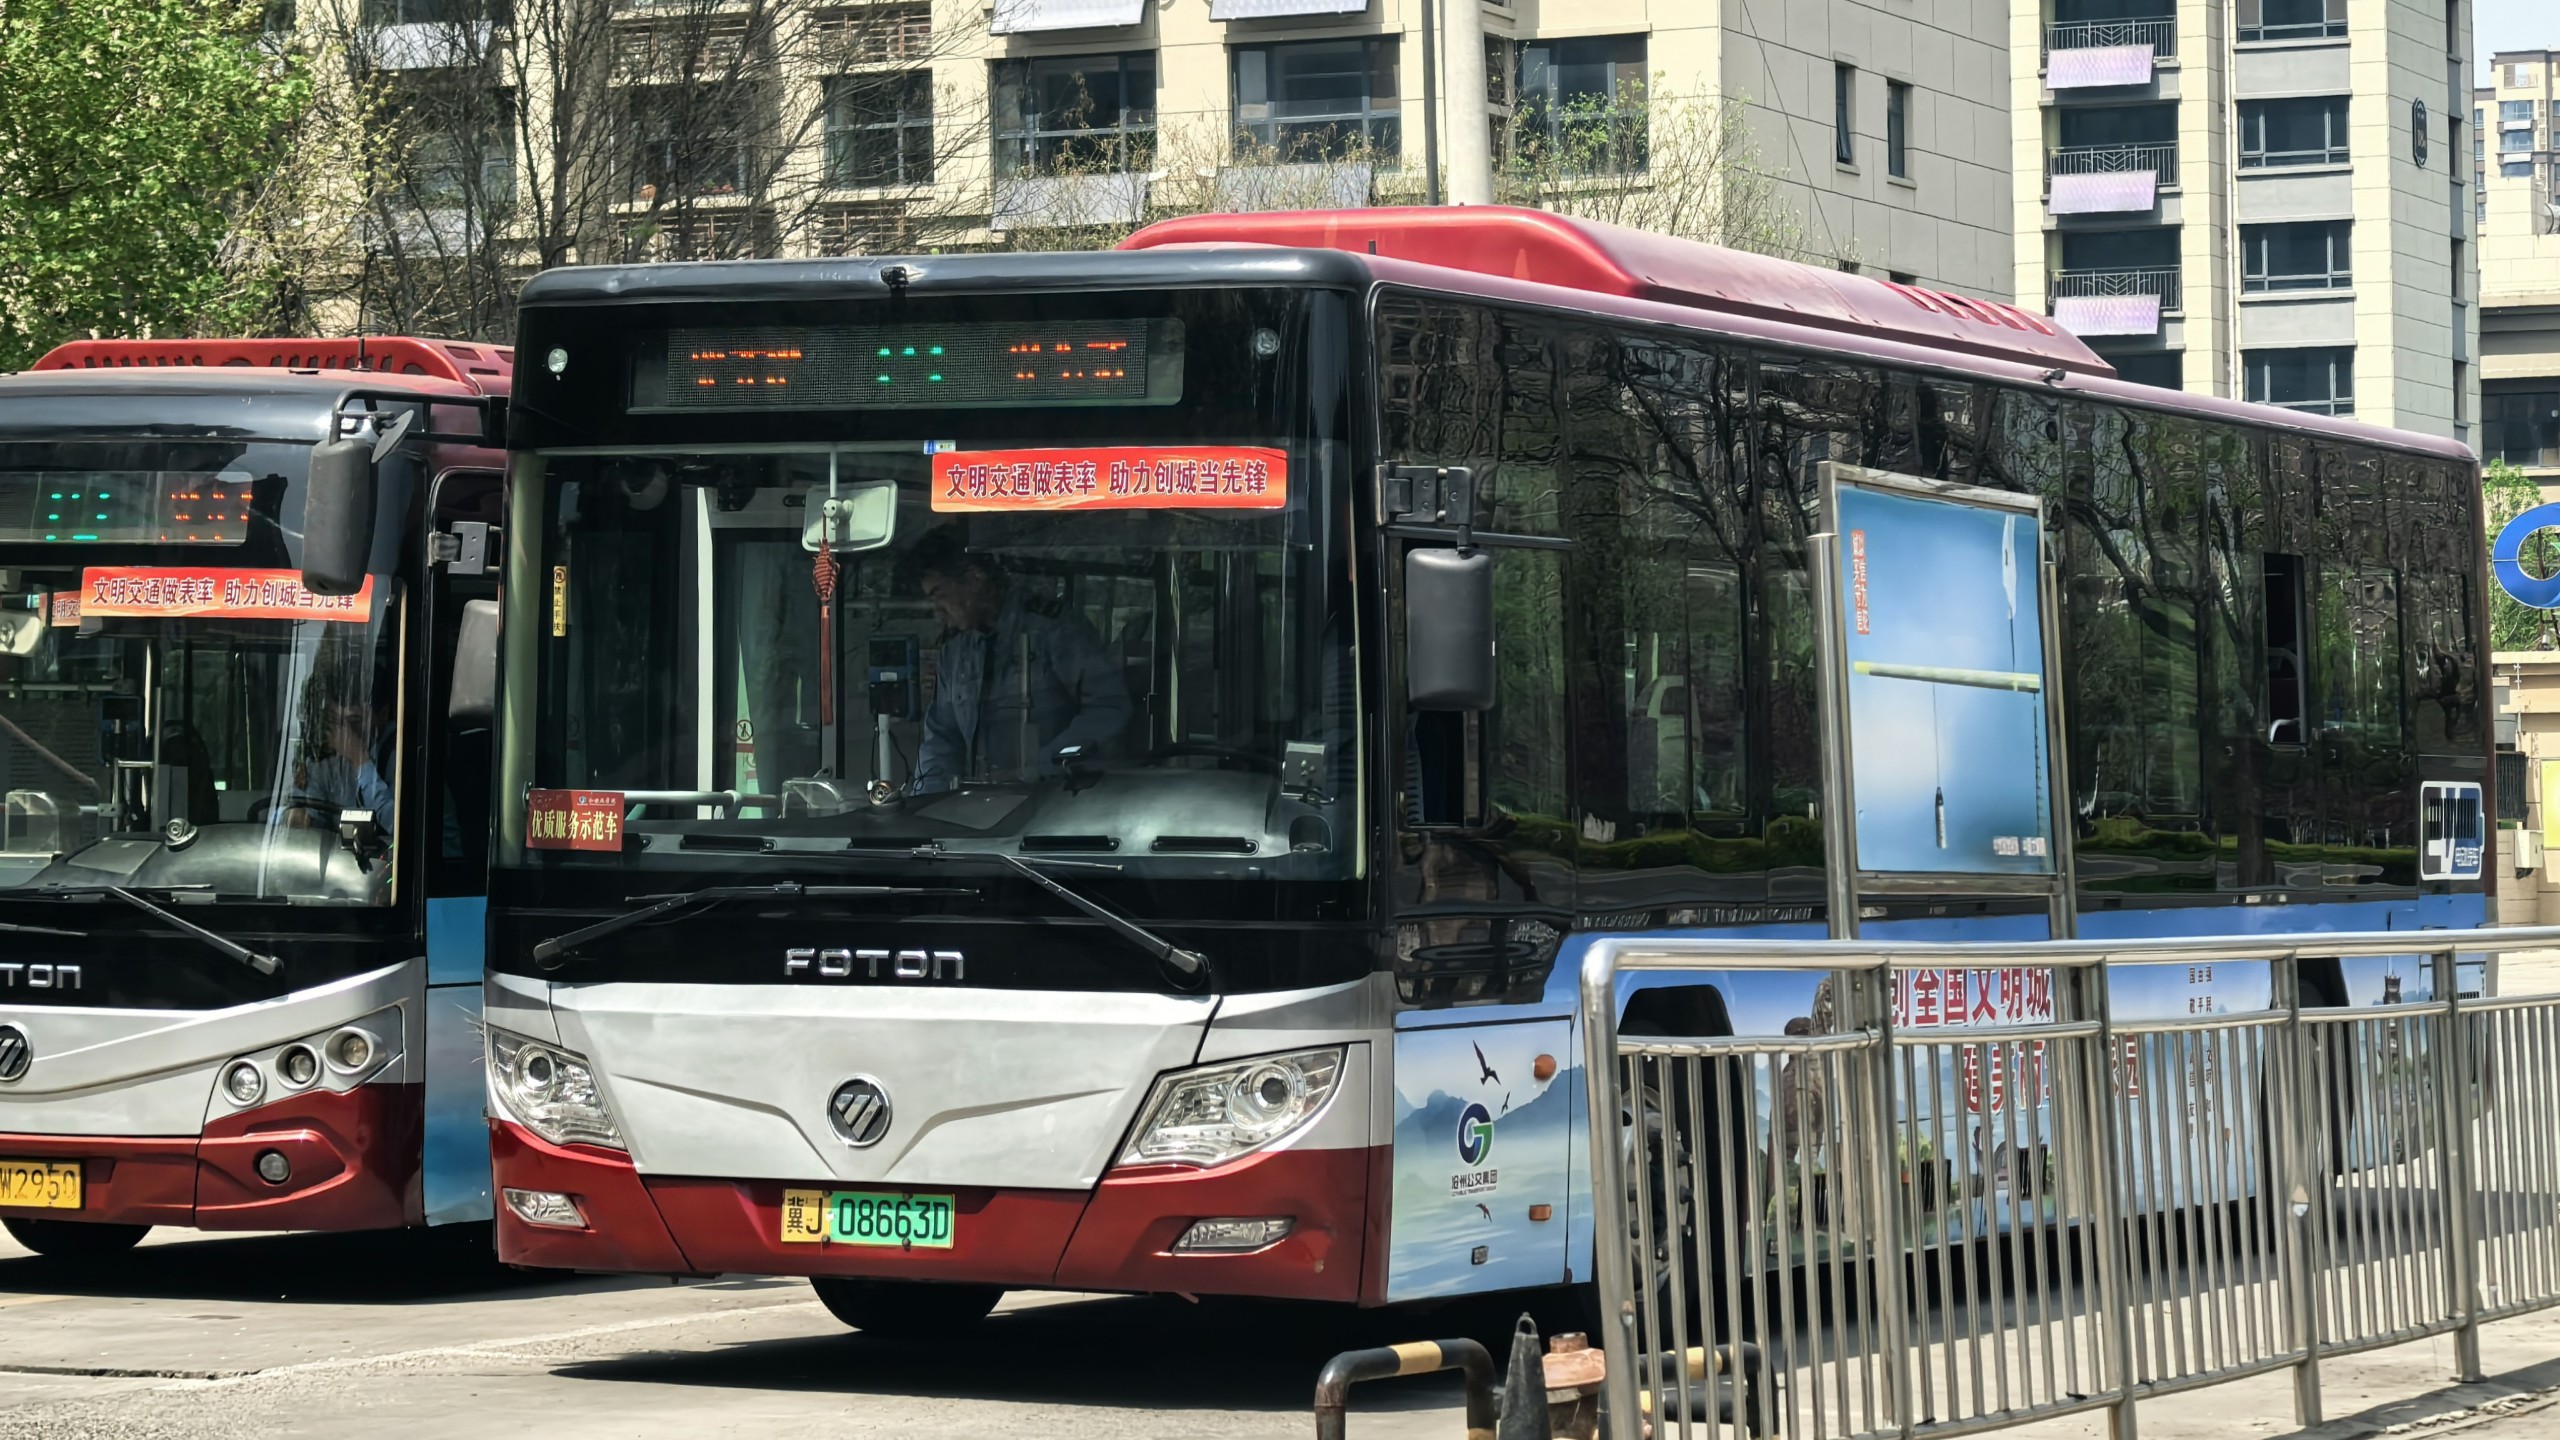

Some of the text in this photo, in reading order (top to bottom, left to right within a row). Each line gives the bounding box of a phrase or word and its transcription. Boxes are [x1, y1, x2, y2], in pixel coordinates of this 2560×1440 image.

[946, 458, 1267, 499] 文明交通做表率 助力创城当先锋
[93, 578, 215, 606] 文明交通做表率
[532, 808, 618, 841] 优质服务示范车
[0, 963, 81, 989] TON
[785, 948, 964, 980] FOTON
